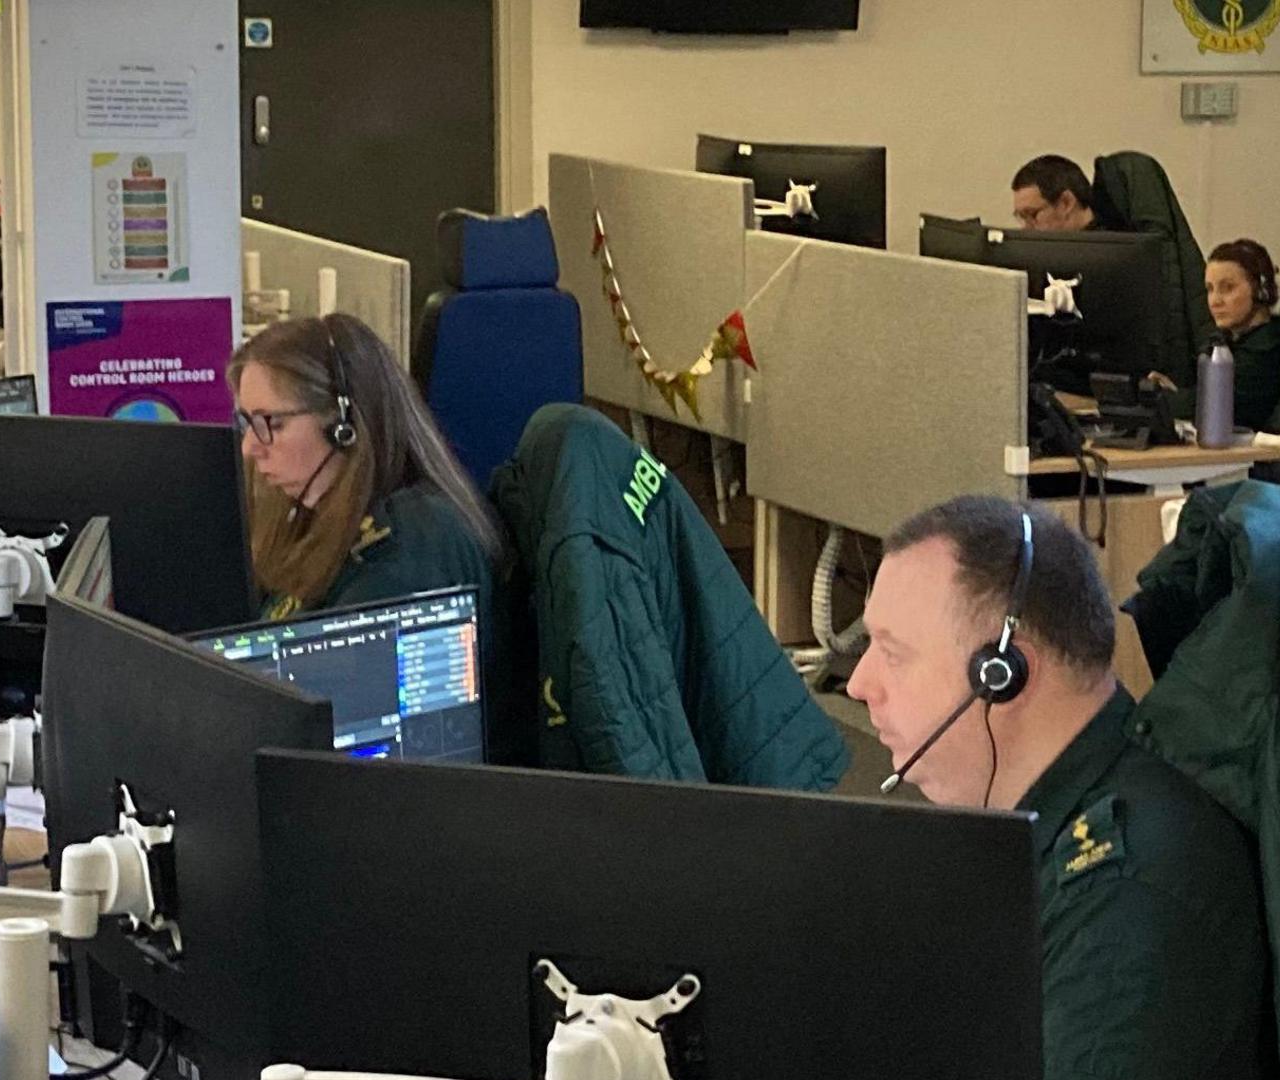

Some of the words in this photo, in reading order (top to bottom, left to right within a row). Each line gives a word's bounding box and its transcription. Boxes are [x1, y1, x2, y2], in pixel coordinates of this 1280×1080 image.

[100, 357, 182, 374] CELEBRATING
[70, 373, 127, 388] CONTROL
[129, 371, 166, 385] ROOM
[167, 368, 215, 383] HEROES
